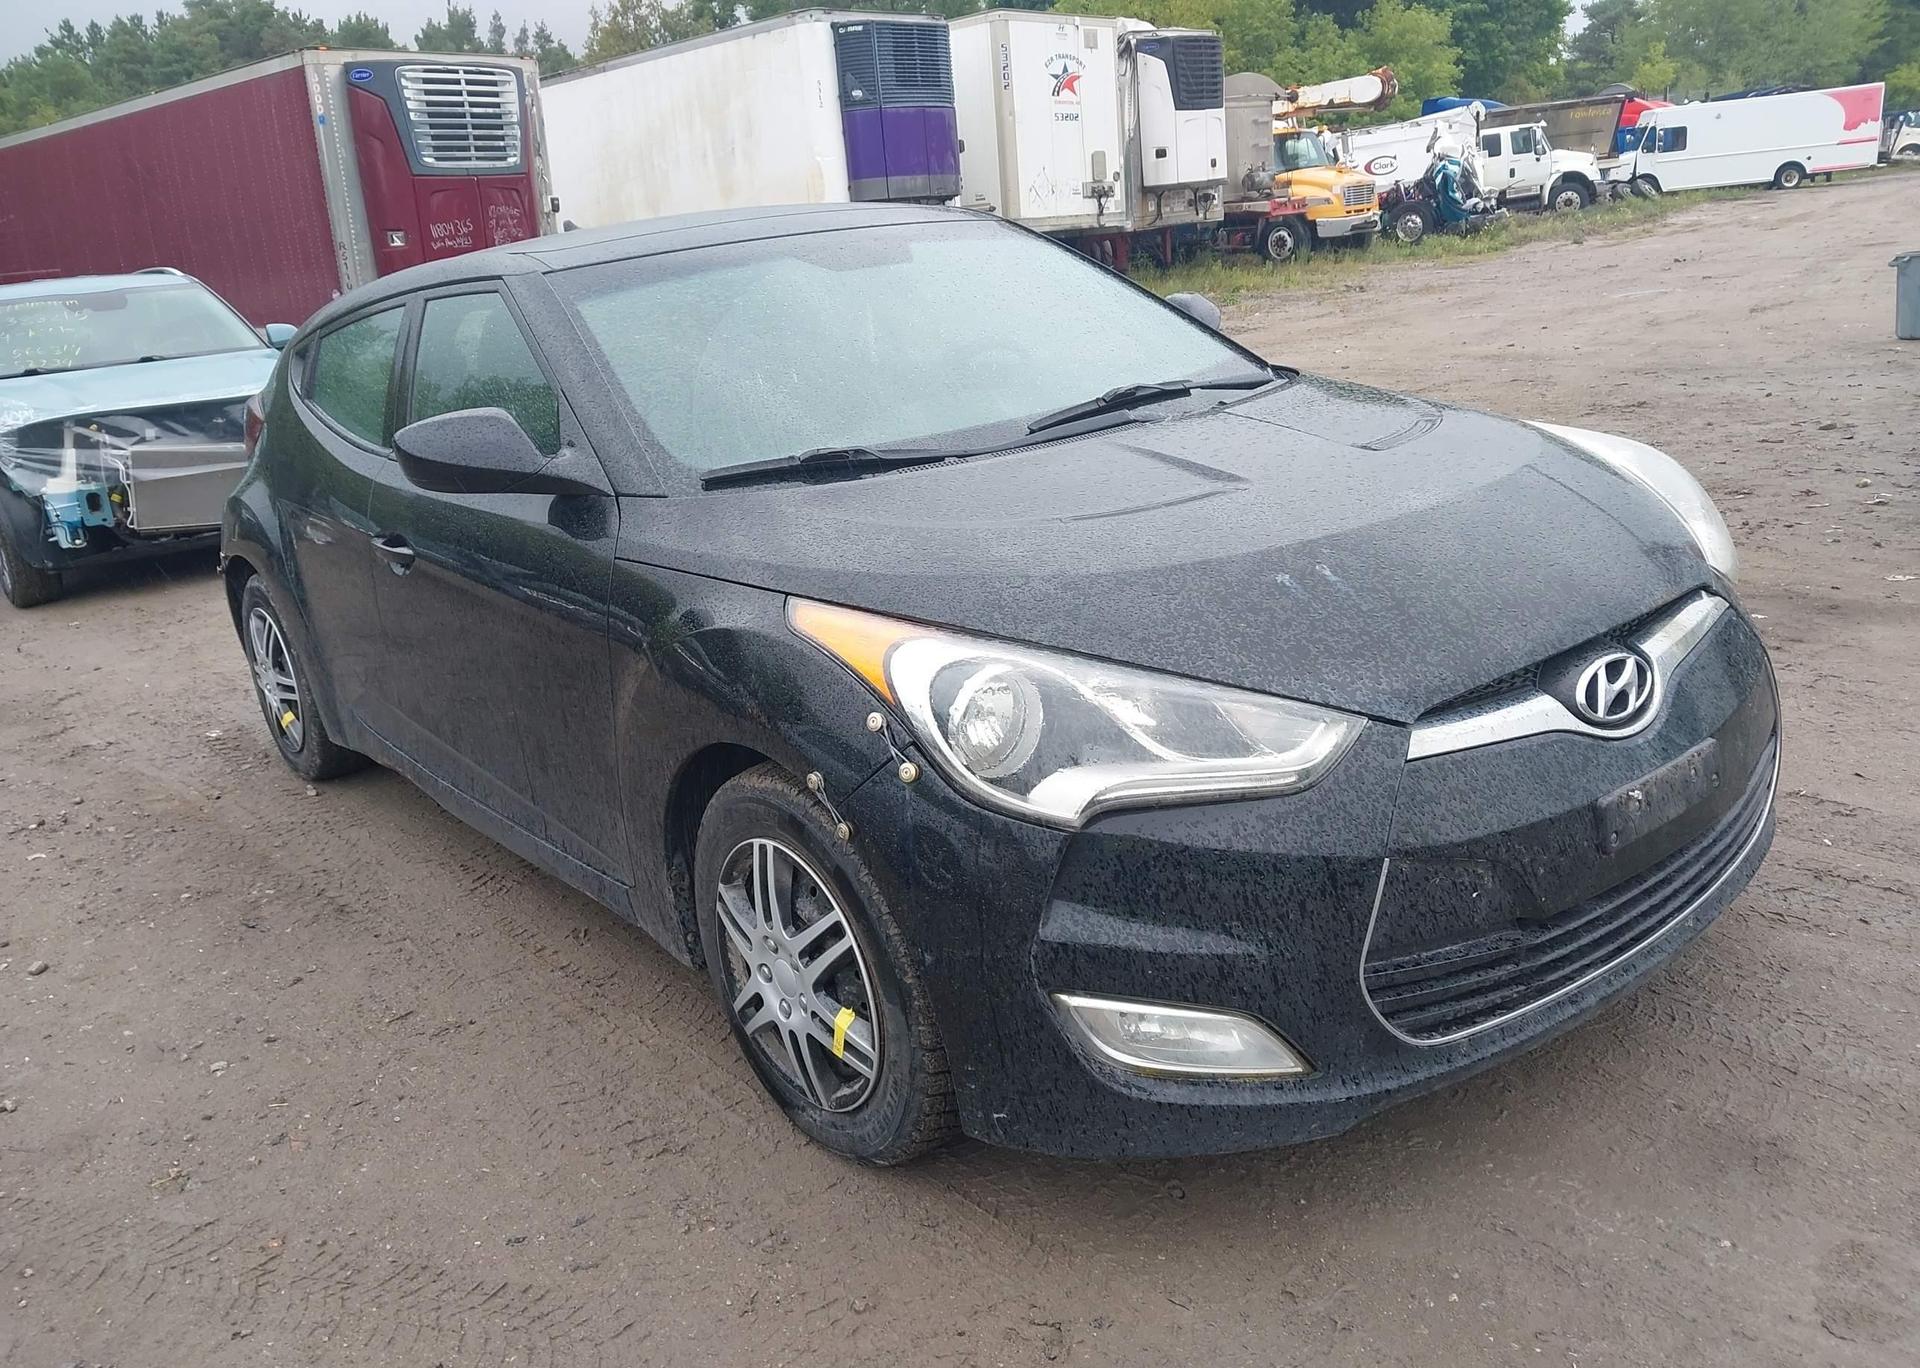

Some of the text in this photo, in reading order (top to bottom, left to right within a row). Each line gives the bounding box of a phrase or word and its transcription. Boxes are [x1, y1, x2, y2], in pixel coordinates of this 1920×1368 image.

[1001, 43, 1010, 90] 53202
[1055, 53, 1087, 70] TRANSPORT
[1054, 112, 1080, 121] 53202
[1373, 160, 1395, 170] Clark
